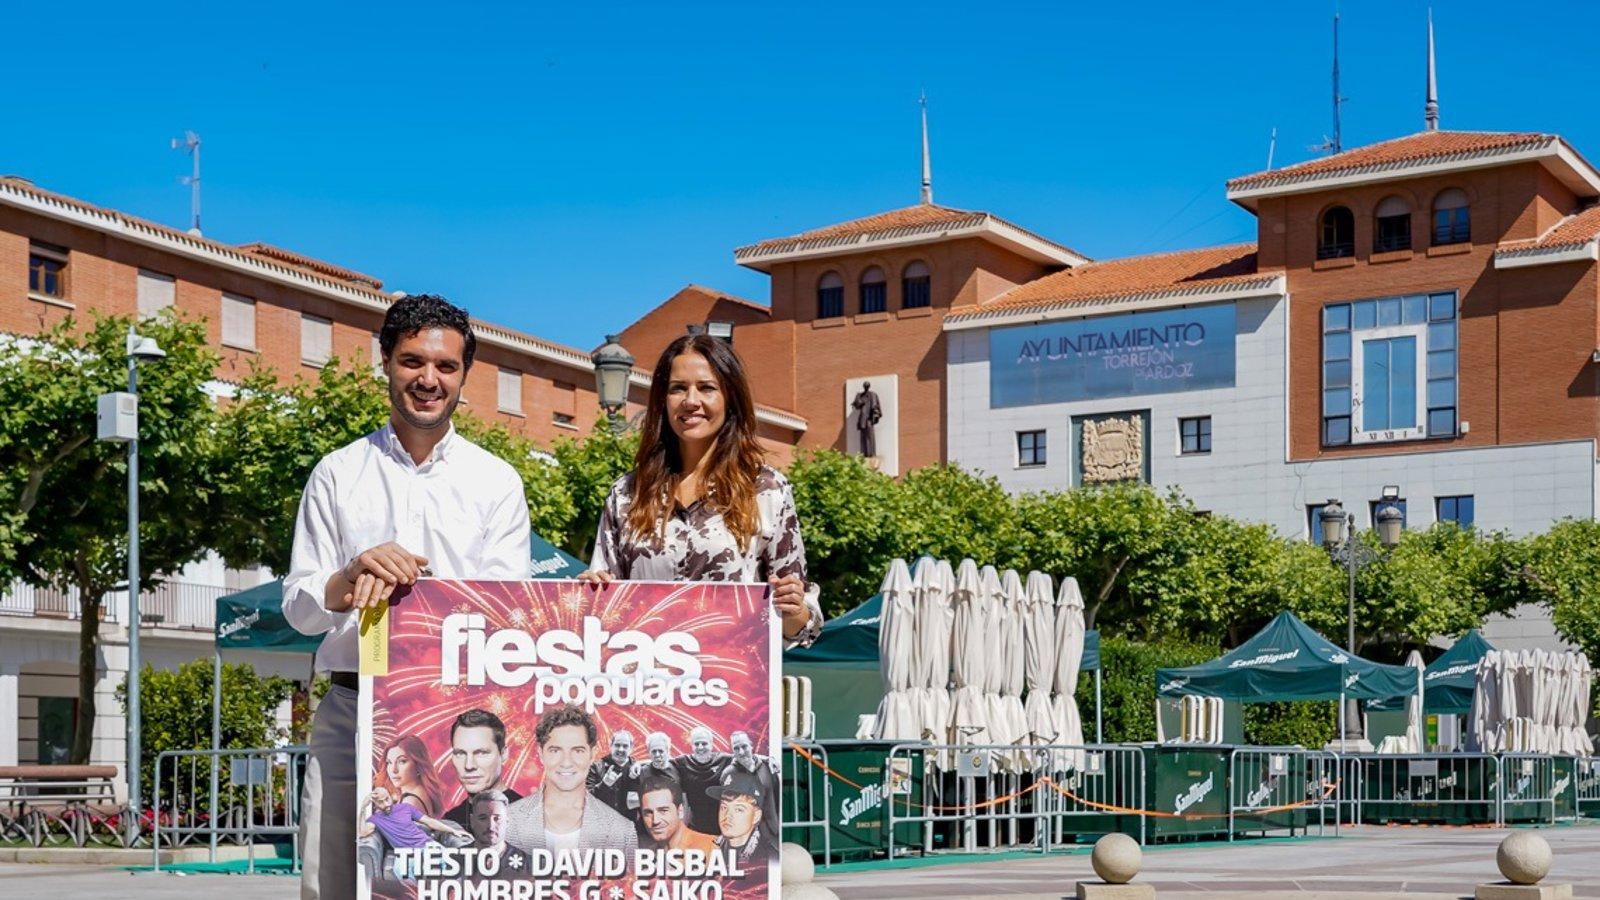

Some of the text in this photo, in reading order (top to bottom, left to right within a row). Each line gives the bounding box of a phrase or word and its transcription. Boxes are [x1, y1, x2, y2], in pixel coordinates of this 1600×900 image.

[1016, 322, 1206, 364] AYUNTAMIENTO
[1102, 348, 1175, 370] TORREJÓN
[1145, 362, 1195, 381] ARDOZ
[441, 612, 702, 687] fiestas
[534, 672, 729, 714] populares
[394, 842, 745, 878] TIËSTO DAVID BISBAL
[417, 880, 723, 900] HOMBRES G SAIKO
